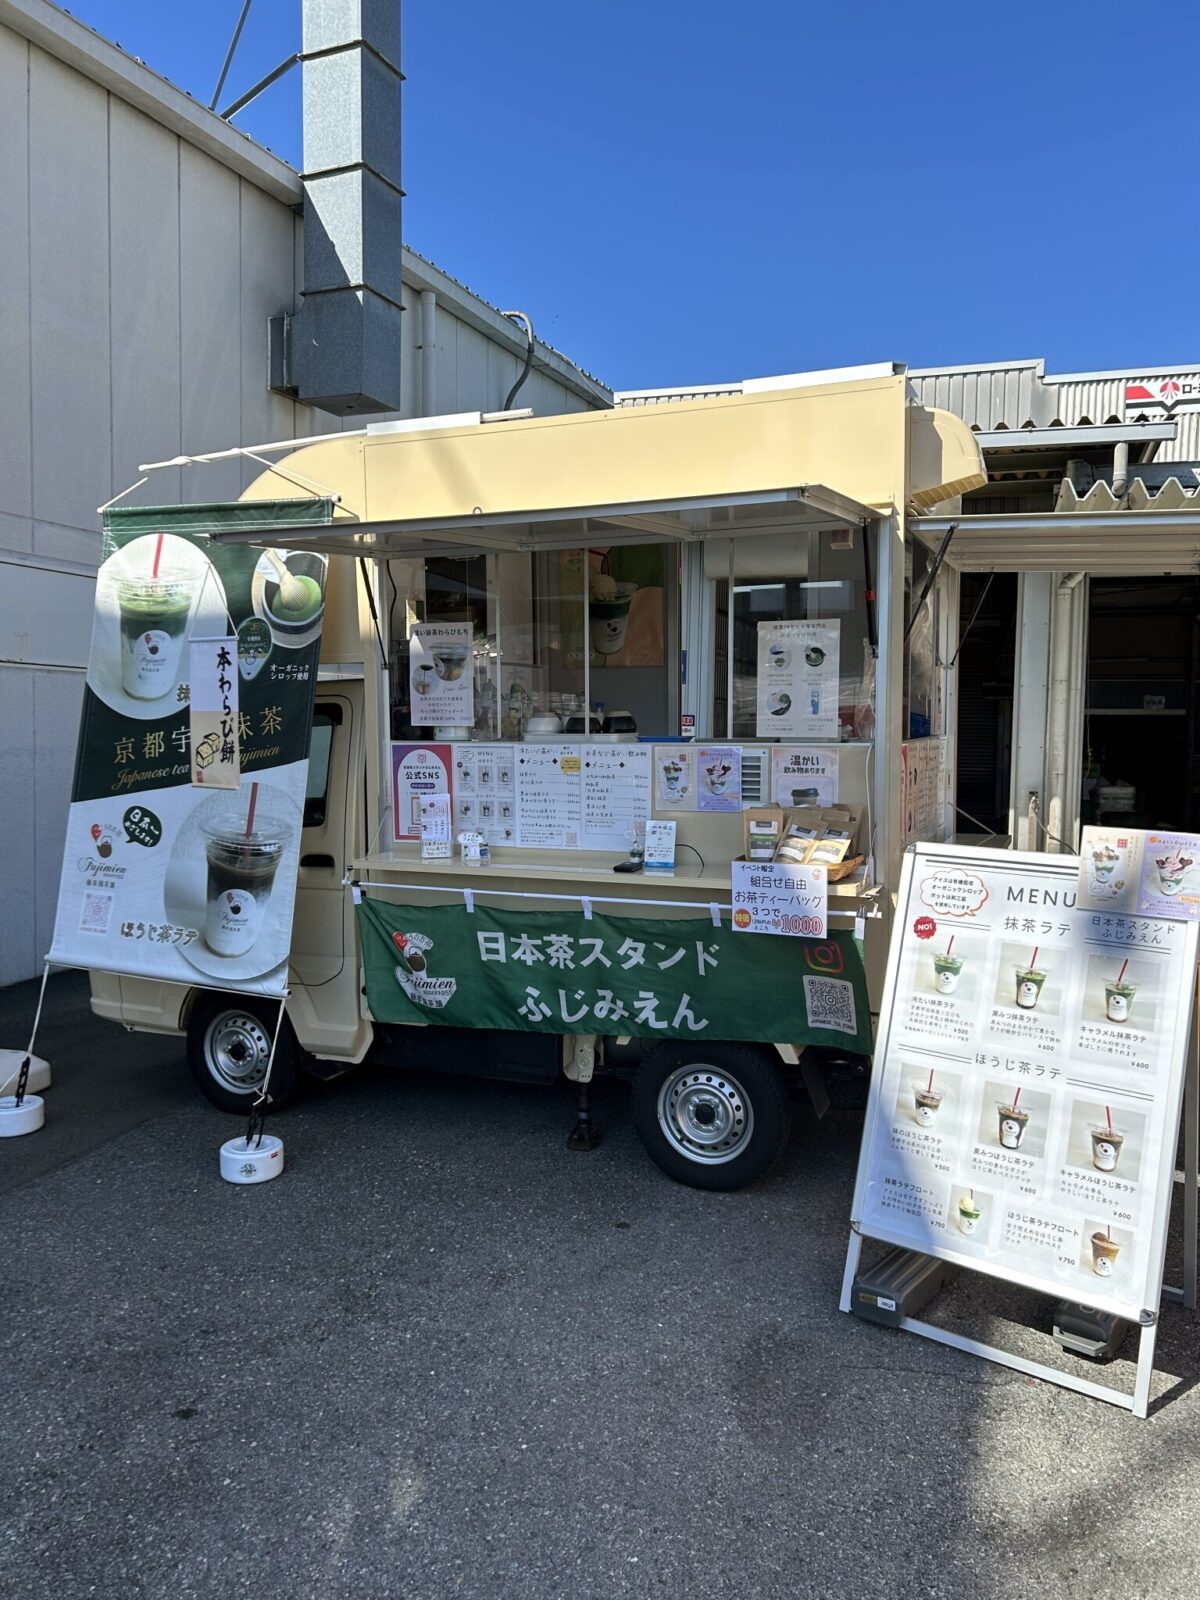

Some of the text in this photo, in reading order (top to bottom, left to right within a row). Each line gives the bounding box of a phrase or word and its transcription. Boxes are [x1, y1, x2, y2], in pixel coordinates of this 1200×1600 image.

[1182, 383, 1200, 395] ロー
[270, 664, 309, 672] オーガニック
[216, 646, 235, 765] 本わらび餅
[790, 754, 820, 766] 温かい
[111, 768, 169, 790] Japanese
[172, 762, 190, 775] tea
[405, 770, 440, 780] 公式SNS
[783, 766, 826, 775] 飲み物あります
[77, 856, 128, 877] Fujimien
[740, 864, 775, 873] イベント限定
[750, 875, 807, 890] 組合せ自由
[932, 885, 984, 895] オーガニックシロップ
[734, 891, 824, 909] お茶ティーバッグ
[934, 901, 971, 910] を使用しています
[1006, 886, 1077, 908] MENU
[752, 906, 781, 918] 3つで
[1004, 915, 1072, 937] 抹茶ラテ
[1092, 915, 1176, 935] 日本茶スタンド
[119, 922, 199, 946] ほうじ茶ラテ
[1101, 928, 1162, 945] ふじみえん
[476, 930, 721, 976] 日本茶スタンド
[516, 985, 710, 1032] ふじみえん
[911, 995, 955, 1009] 冷たい抹茶ラテ
[992, 1010, 1039, 1024] 黒みつ抹茶ラテ
[1081, 1025, 1147, 1043] キャラメル抹茶ラテ
[974, 1052, 1062, 1080] ほうじ茶ラテ
[1131, 1061, 1150, 1070] ¥600
[973, 1147, 1035, 1169] 黒みつほうじ茶ラテ
[884, 1177, 935, 1196] 抹茶ラテフロート
[1060, 1169, 1136, 1193] キャラメルほうじ茶ラテ
[1007, 1210, 1080, 1237] ほうじ茶ラテフロート
[1113, 1210, 1132, 1220] ¥600
[930, 1219, 946, 1229] ¥750
[1058, 1255, 1076, 1266] ¥750
